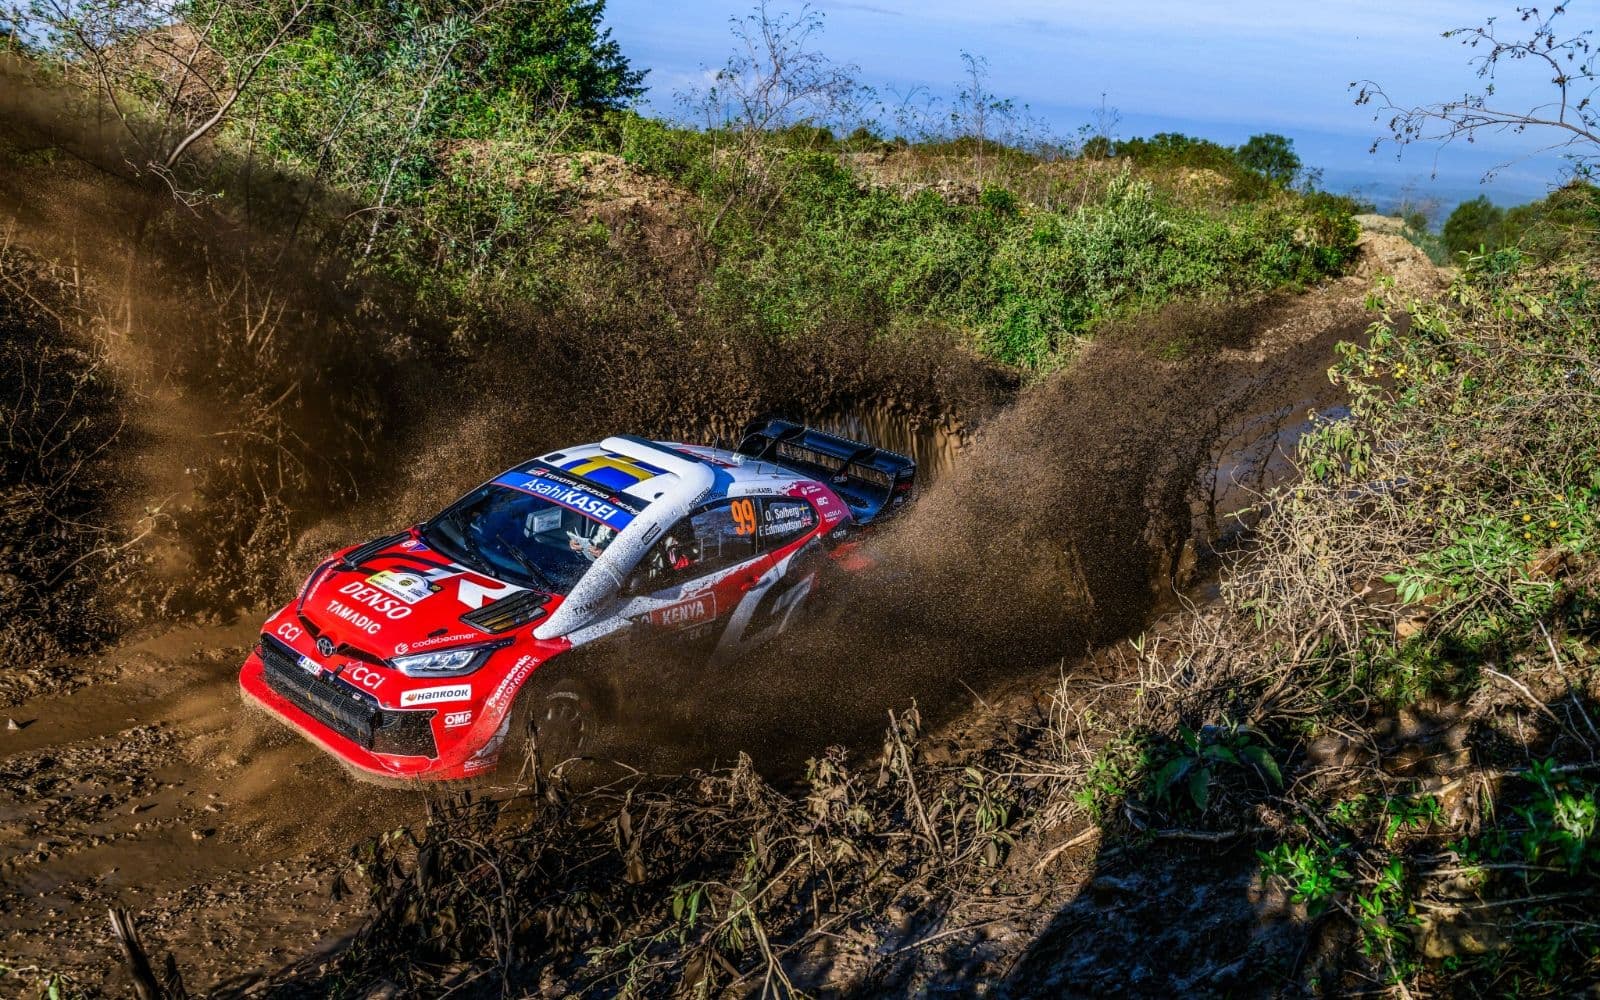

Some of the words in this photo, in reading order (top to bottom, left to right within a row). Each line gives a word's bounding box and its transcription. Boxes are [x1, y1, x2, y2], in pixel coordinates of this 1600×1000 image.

[522, 478, 618, 521] AsahiKASEI
[731, 498, 756, 536] 99
[774, 506, 800, 520] Solberg
[764, 519, 802, 536] Edmondson
[327, 600, 382, 635] TAMADIC
[339, 581, 412, 619] DENSO
[662, 600, 705, 625] KENYA
[411, 632, 474, 648] codebeamer
[487, 654, 532, 708] Panasonic
[496, 656, 541, 714] AUTOMOTIVE
[444, 713, 472, 725] OMP
